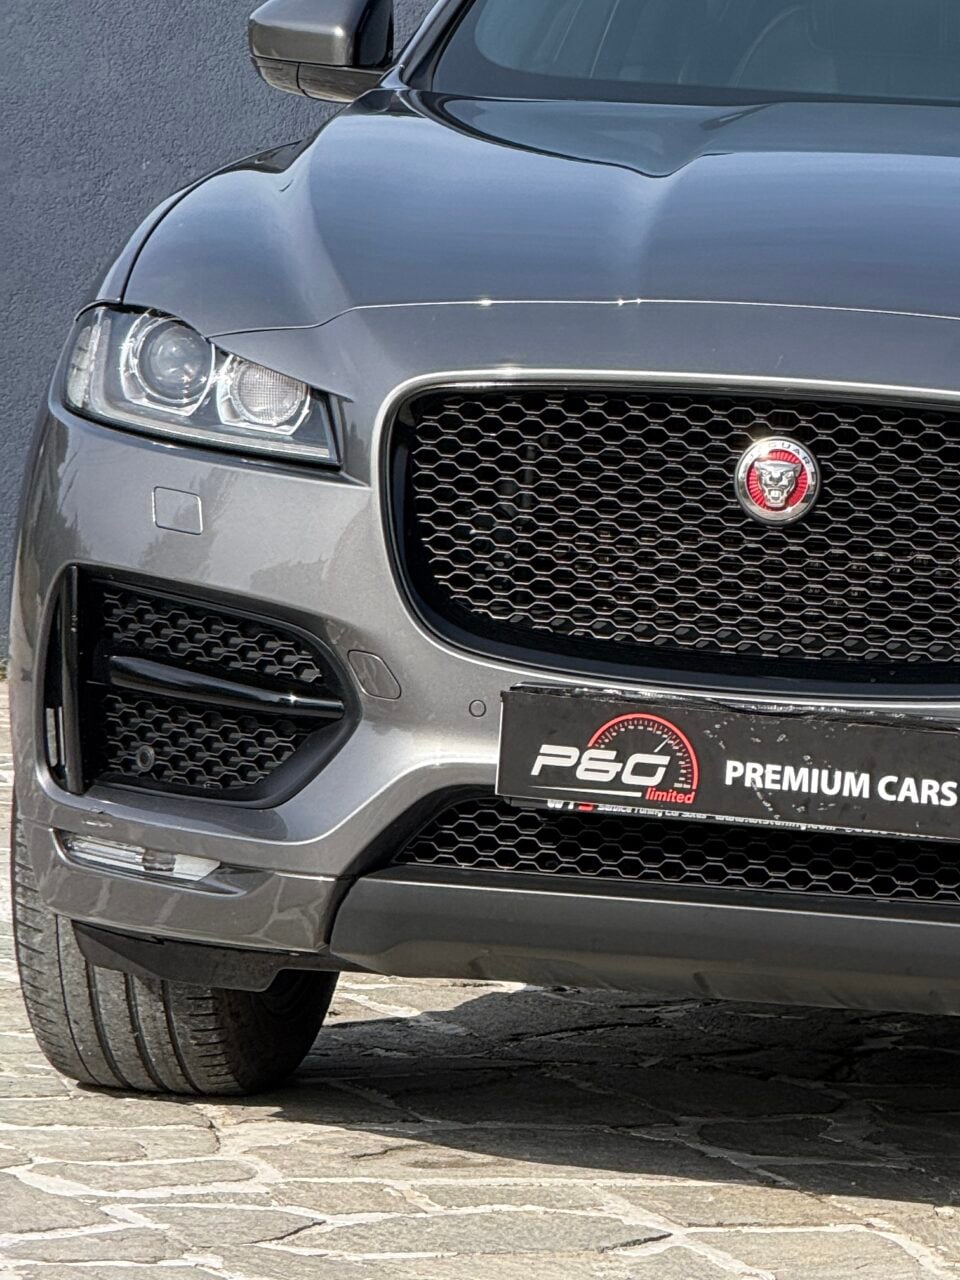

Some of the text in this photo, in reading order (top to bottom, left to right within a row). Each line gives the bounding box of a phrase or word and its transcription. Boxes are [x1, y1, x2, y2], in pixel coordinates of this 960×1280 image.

[530, 744, 671, 787] P&G
[724, 759, 870, 799] PREMIUM
[877, 774, 958, 807] CARS
[645, 787, 696, 804] limited
